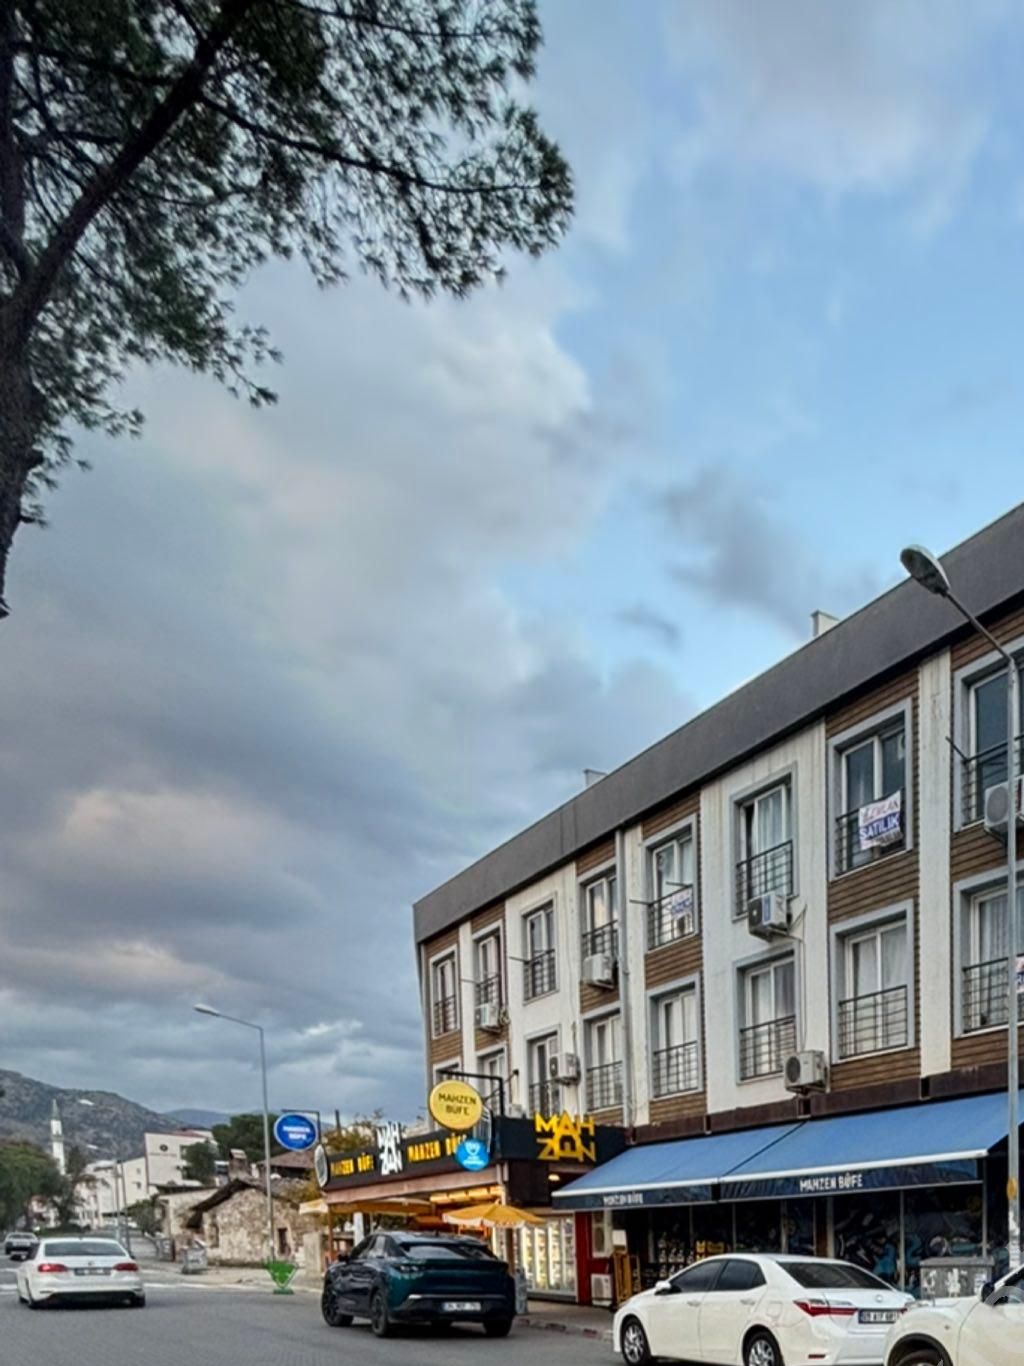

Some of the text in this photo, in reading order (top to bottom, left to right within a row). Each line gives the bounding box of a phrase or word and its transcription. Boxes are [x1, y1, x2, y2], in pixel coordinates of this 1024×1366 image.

[438, 1093, 477, 1105] MAHZEN
[406, 1140, 440, 1162] MAHZEN
[800, 1171, 863, 1193] MAHZEN BÜFE
